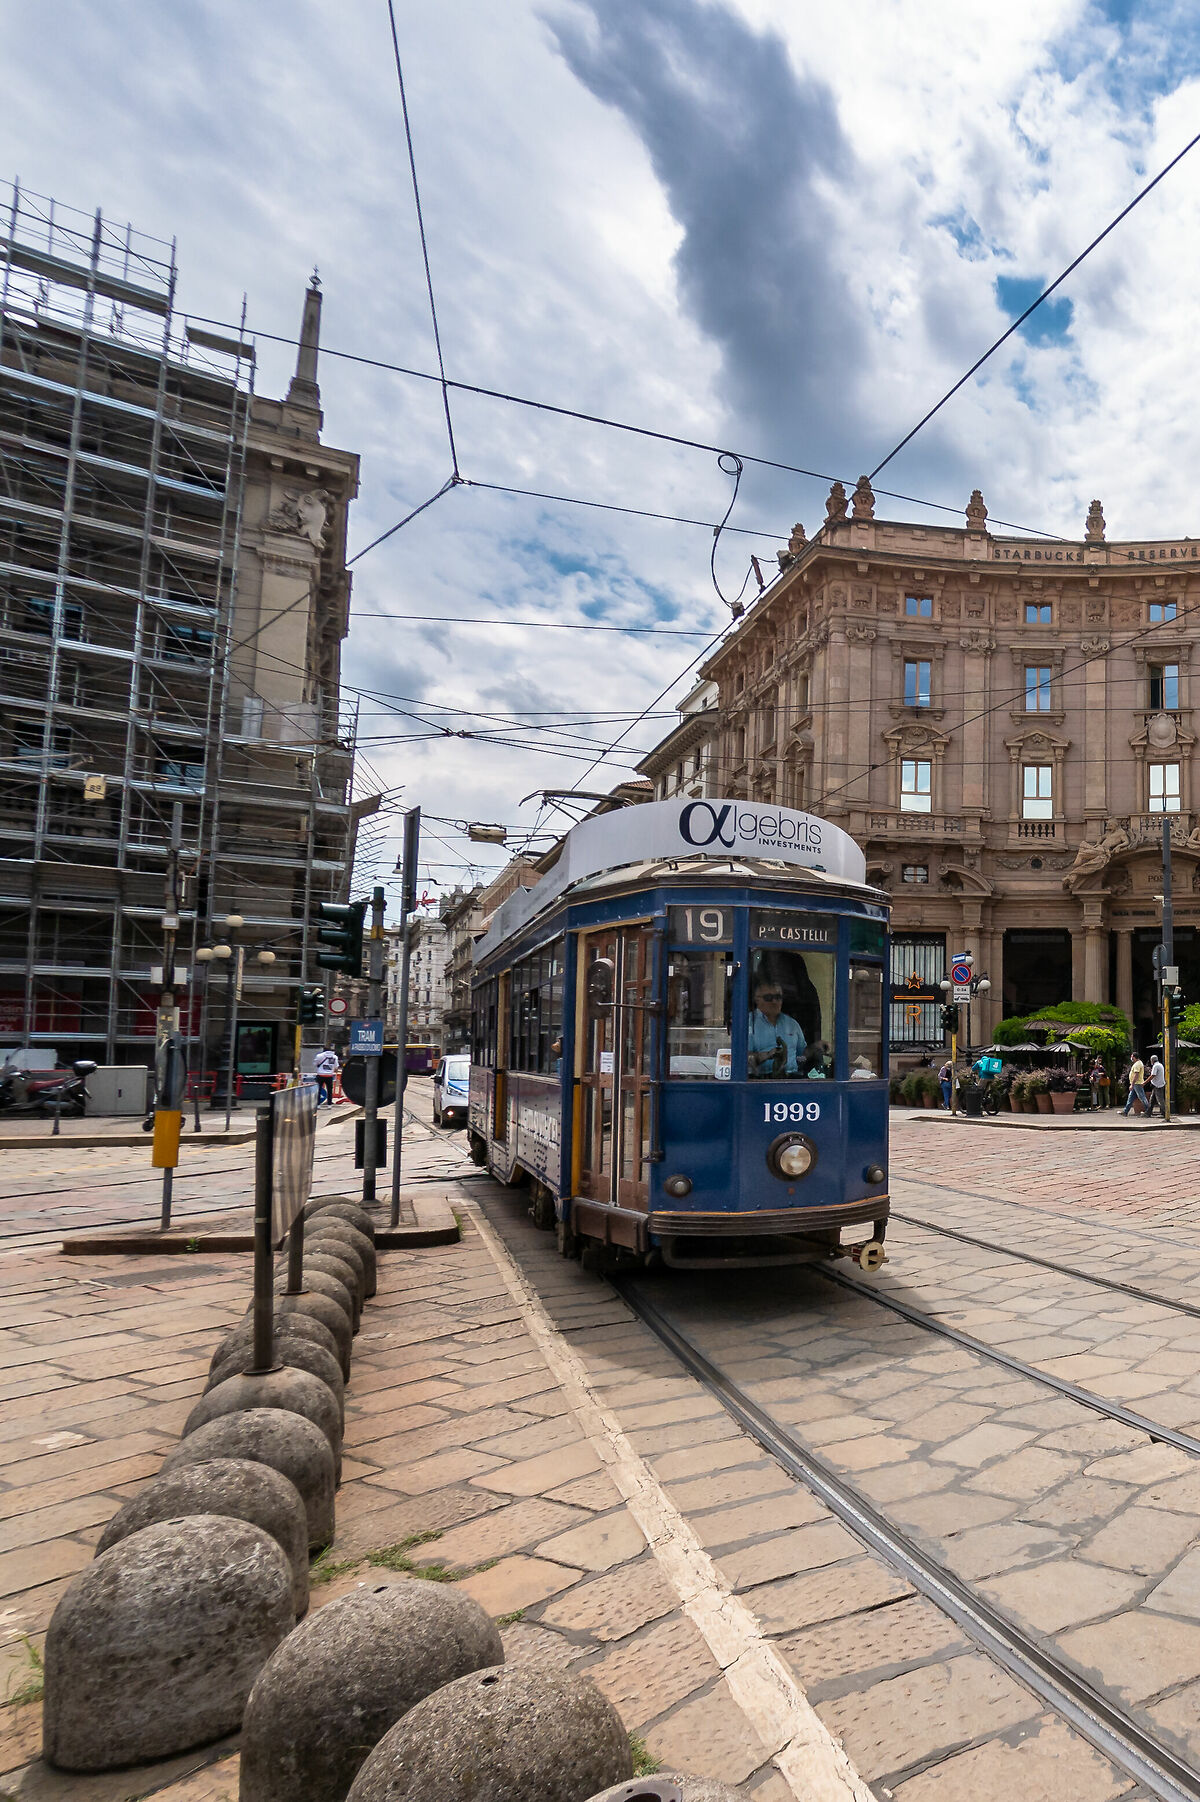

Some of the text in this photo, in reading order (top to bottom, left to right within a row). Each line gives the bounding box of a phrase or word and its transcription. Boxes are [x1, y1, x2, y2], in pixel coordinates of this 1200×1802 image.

[994, 549, 1084, 561] STARBUCKS
[1128, 547, 1198, 561] RESERVE
[758, 837, 822, 854] INVESTMENTS
[1147, 874, 1177, 883] POSE
[685, 908, 724, 942] 19
[780, 926, 829, 943] CASTELLI
[906, 1005, 922, 1025] R
[357, 1030, 375, 1041] TRAM
[720, 1066, 731, 1077] 19
[764, 1102, 821, 1122] 1999
